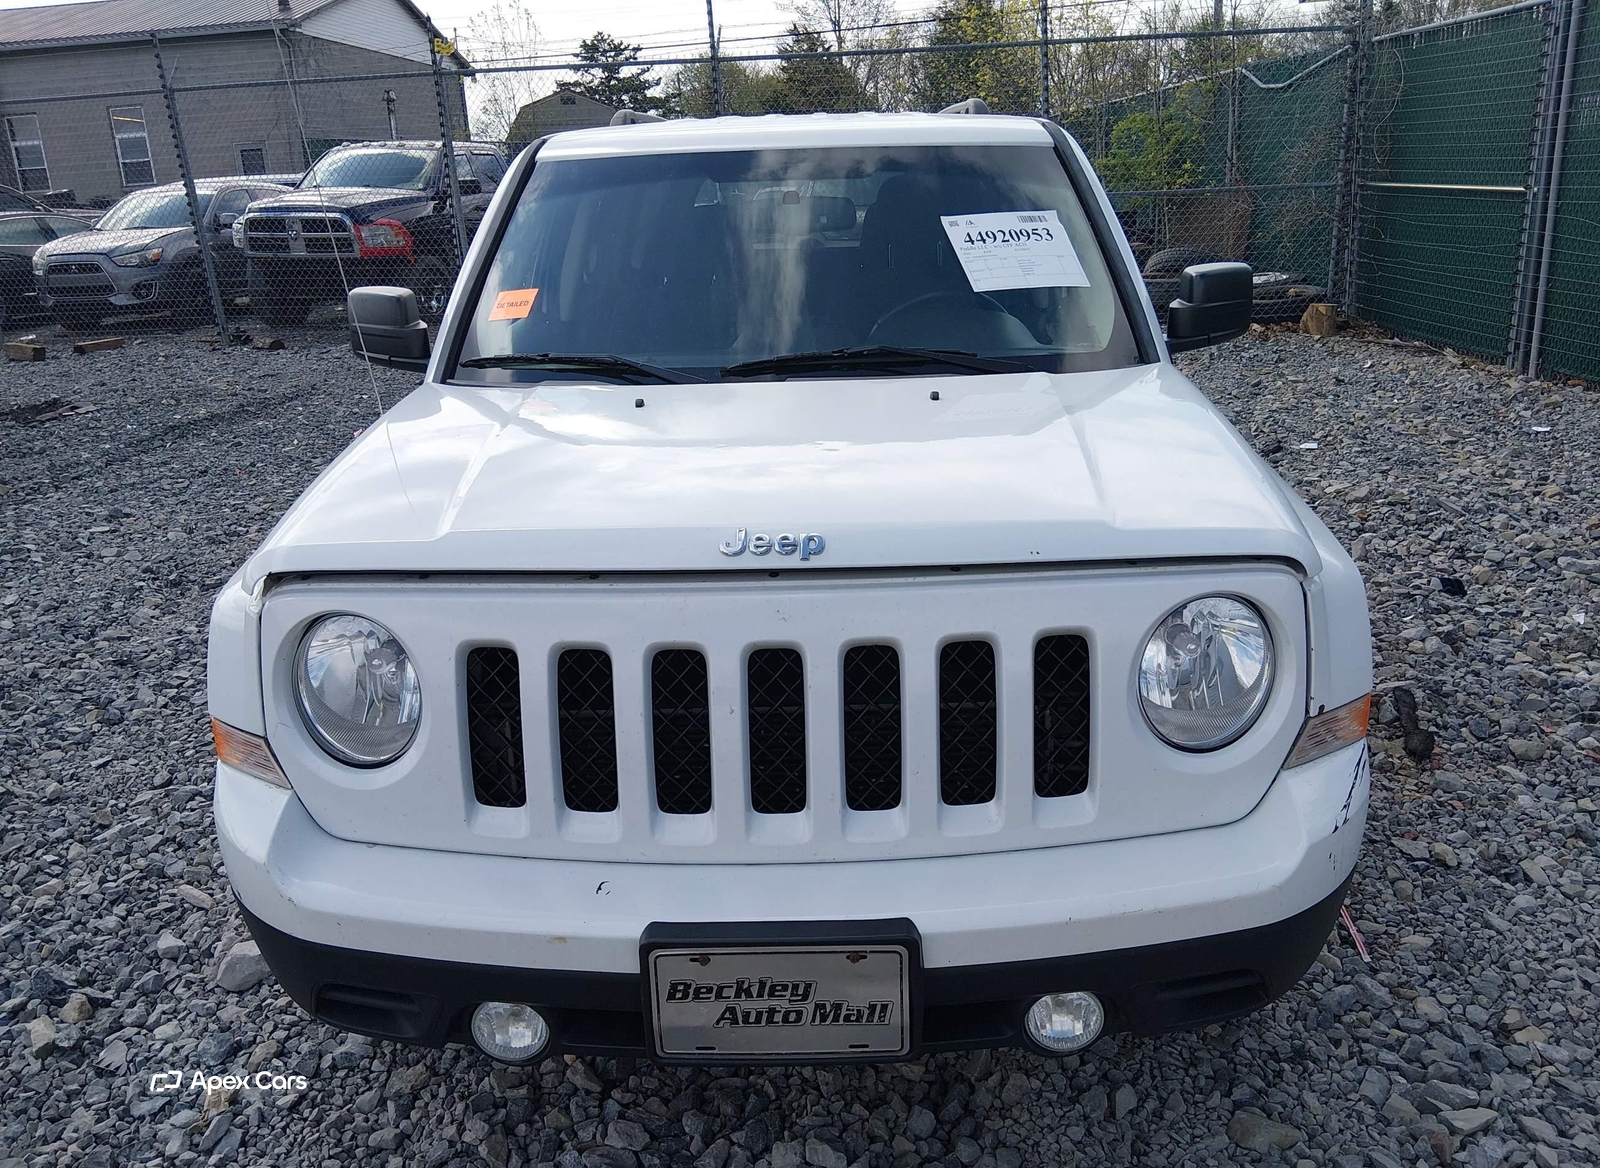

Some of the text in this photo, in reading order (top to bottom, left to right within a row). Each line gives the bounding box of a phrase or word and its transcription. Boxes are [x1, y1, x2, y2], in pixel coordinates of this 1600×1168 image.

[963, 227, 1054, 246] 44920953
[496, 300, 529, 309] DETAILED
[718, 527, 826, 561] Jeep
[666, 977, 817, 1004] Beckley
[713, 1000, 894, 1028] Auto Mall
